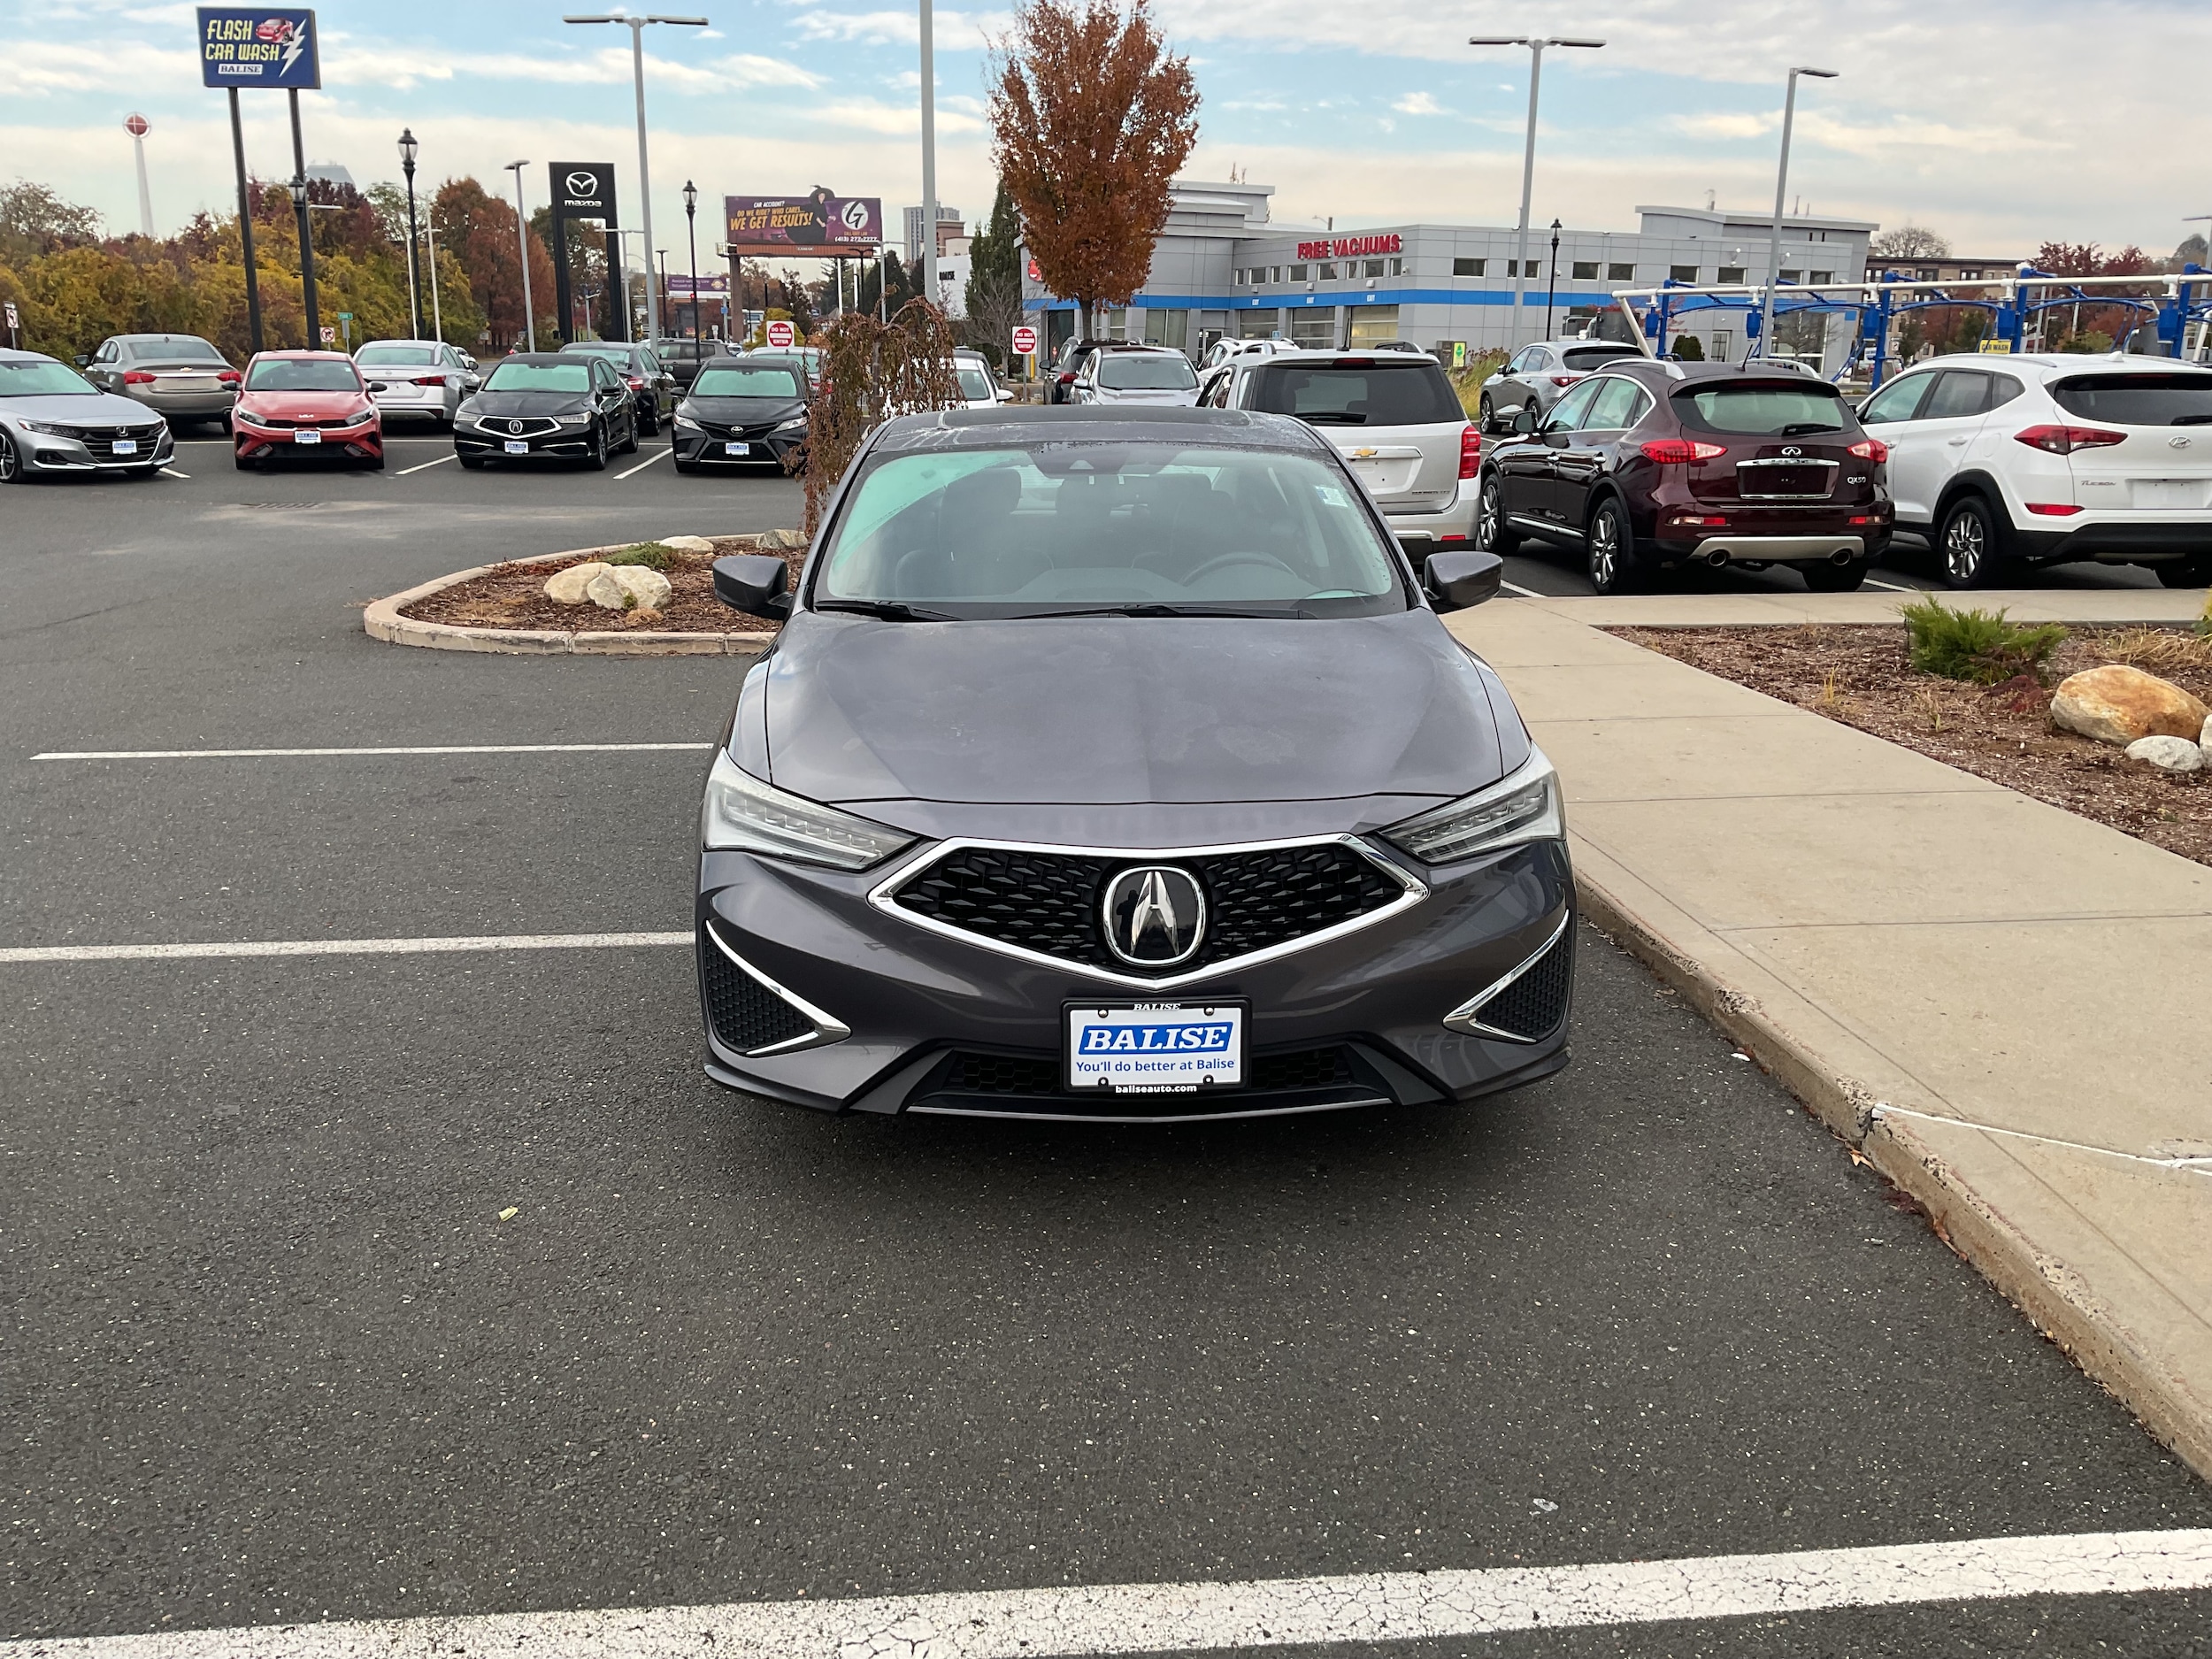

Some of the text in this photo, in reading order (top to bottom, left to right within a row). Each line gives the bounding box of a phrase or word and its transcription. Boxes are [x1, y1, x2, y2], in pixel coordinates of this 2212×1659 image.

[207, 19, 253, 41] FLASH
[205, 43, 280, 61] CAR WASH
[220, 65, 261, 73] BALISE
[730, 212, 813, 231] WE GET RESULTS!
[1297, 234, 1402, 259] FREE VACUUMS
[1084, 1025, 1228, 1050] BALISE
[1076, 1059, 1234, 1071] You'll do better at Balise
[1115, 1084, 1197, 1094] baliseauto.com
